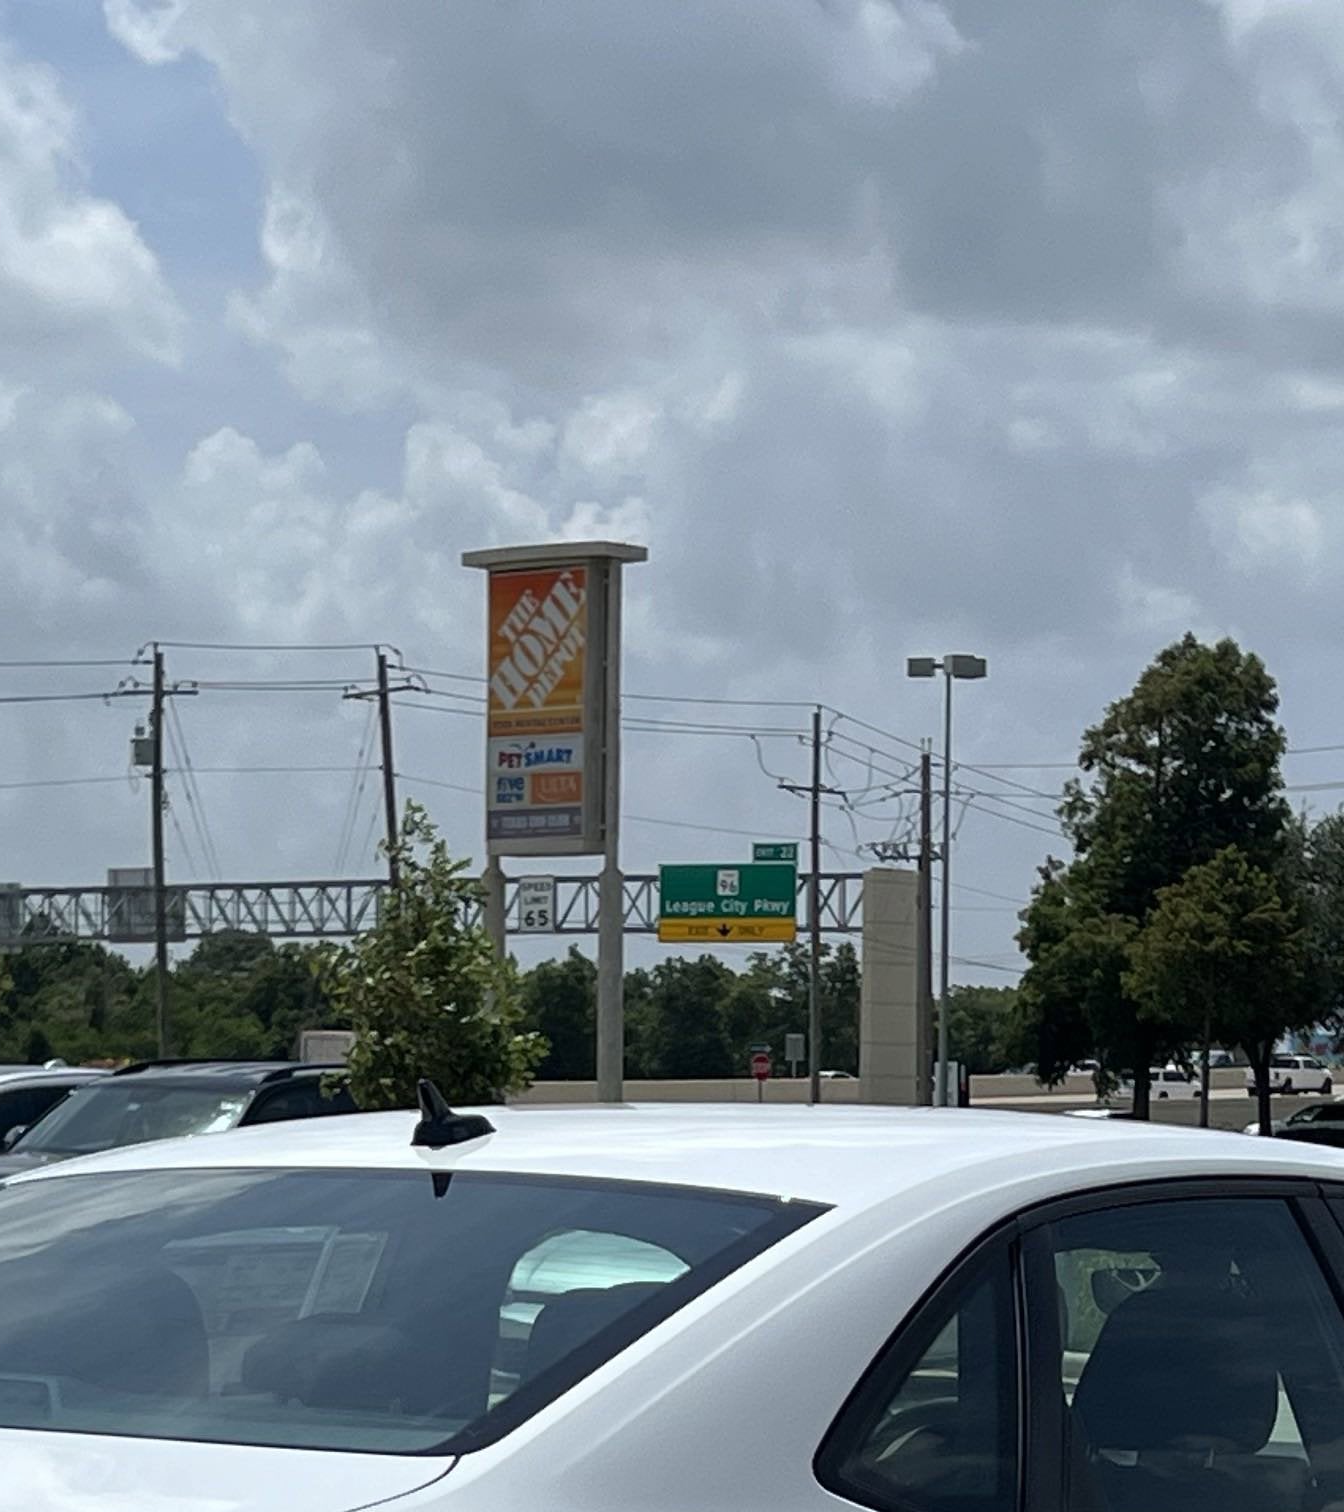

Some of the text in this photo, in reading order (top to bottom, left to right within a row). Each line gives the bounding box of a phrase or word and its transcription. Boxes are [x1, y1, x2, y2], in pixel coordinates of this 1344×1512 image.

[497, 588, 540, 640] THE
[489, 571, 585, 710] HOME
[525, 622, 586, 710] DEPOT
[720, 880, 738, 893] 96
[525, 910, 549, 926] 65
[665, 899, 790, 915] League City Pkwy
